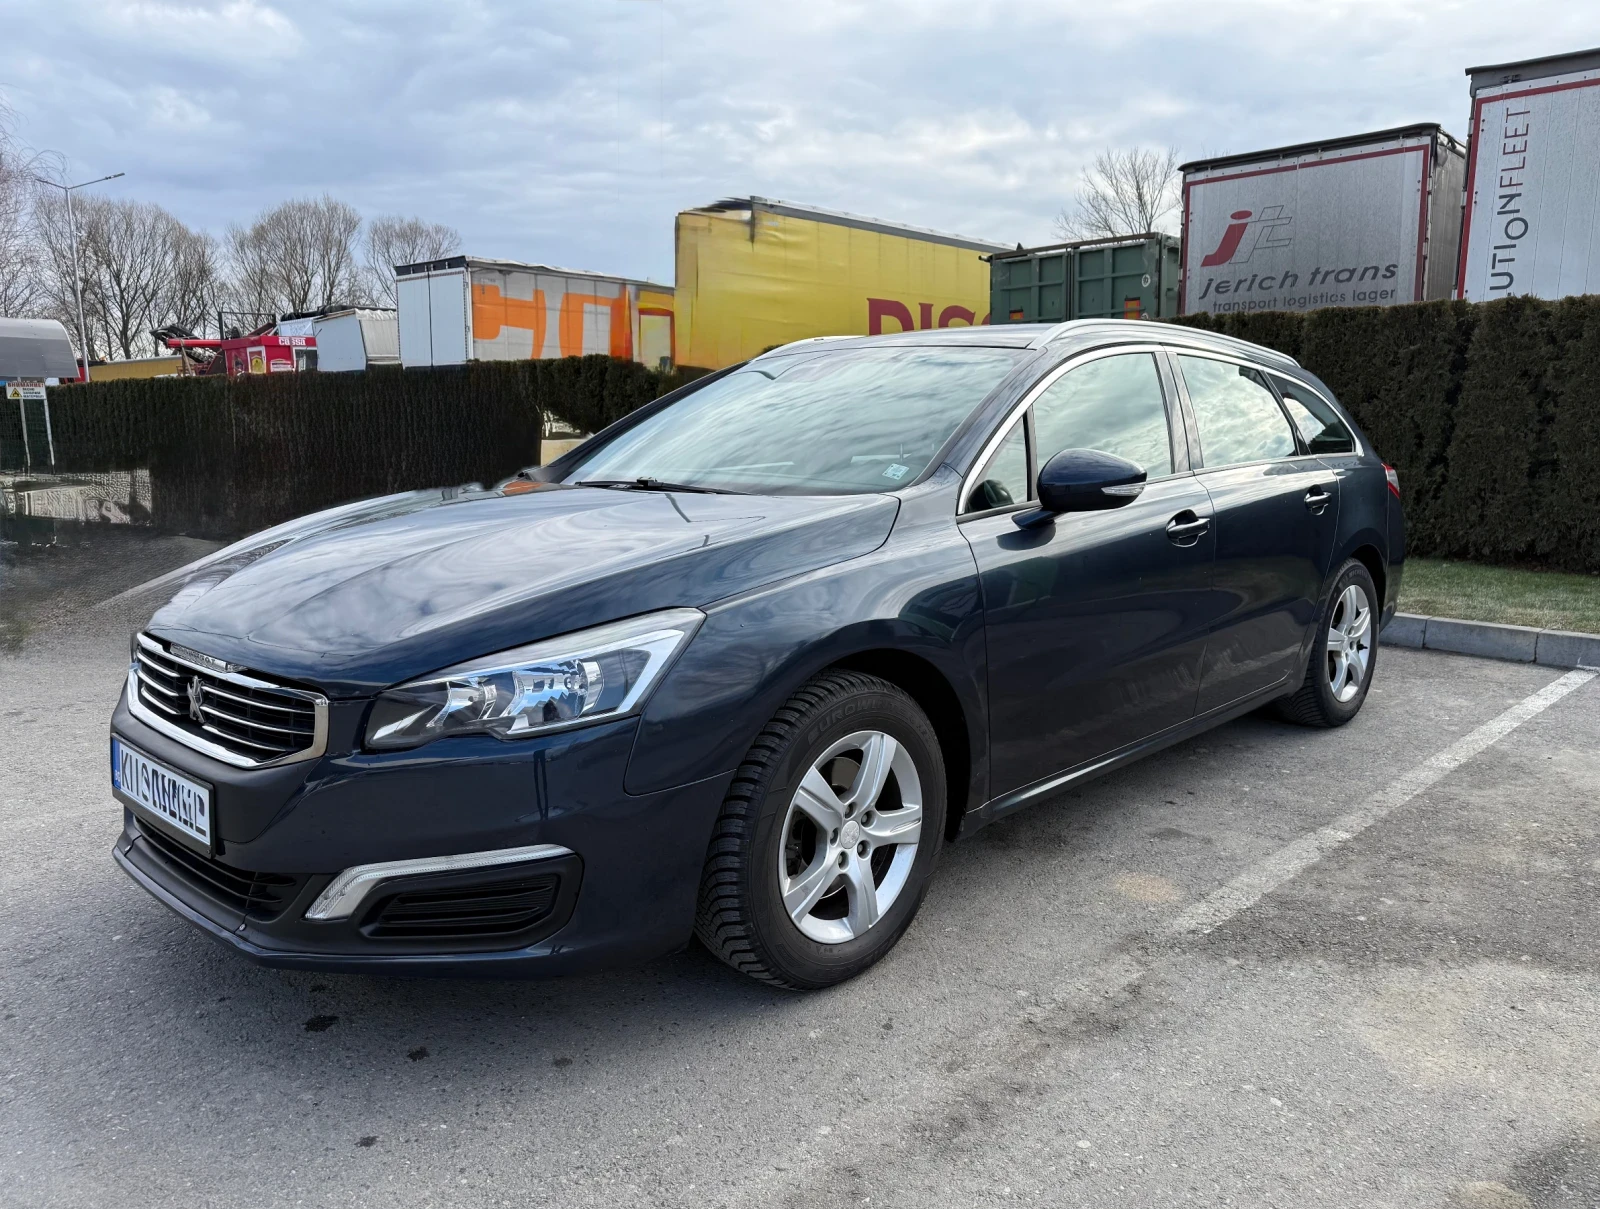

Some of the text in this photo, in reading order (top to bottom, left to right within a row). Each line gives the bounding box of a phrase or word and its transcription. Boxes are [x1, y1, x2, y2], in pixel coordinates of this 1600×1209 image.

[1489, 107, 1531, 297] UTIONFLEET
[1199, 263, 1399, 300] jerich trans
[1212, 288, 1396, 313] transport logistics lager
